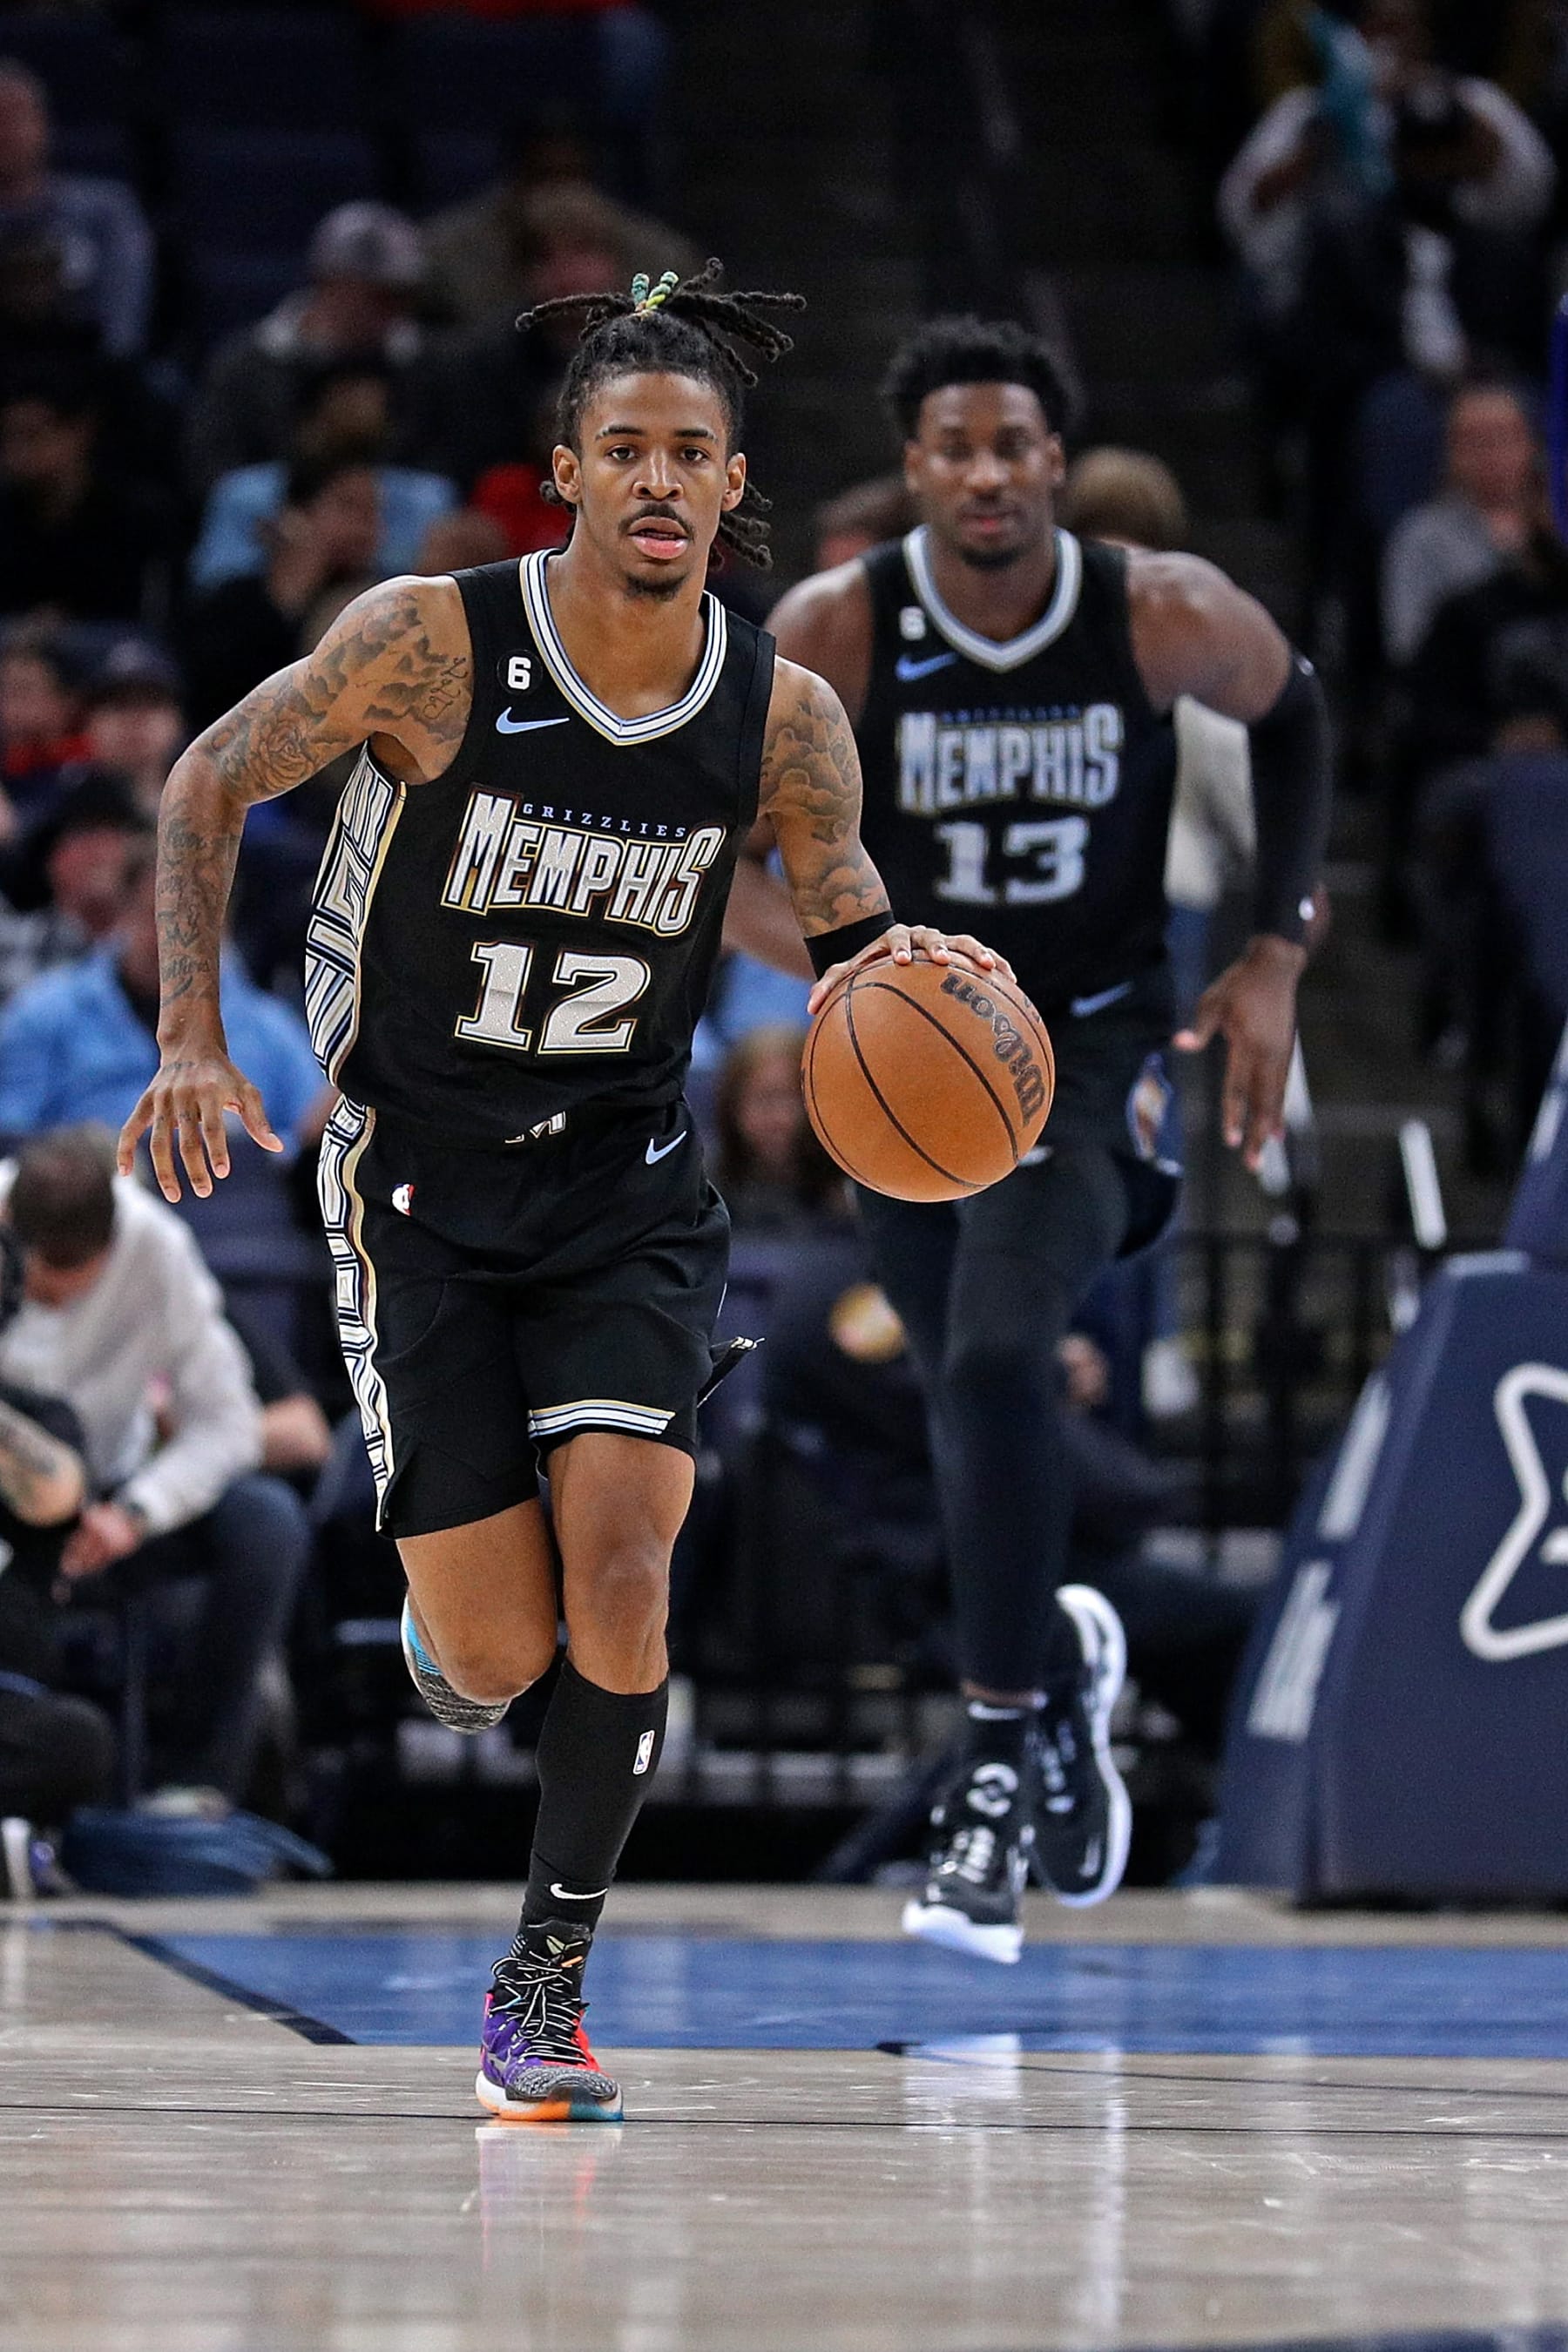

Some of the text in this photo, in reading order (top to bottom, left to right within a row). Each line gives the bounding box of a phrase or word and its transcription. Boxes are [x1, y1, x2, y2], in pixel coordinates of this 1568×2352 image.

[506, 656, 532, 690] 6
[896, 702, 1125, 814] MEMPHIS
[442, 787, 726, 936] MEMPHIS
[522, 802, 686, 838] GRIZZLIES
[934, 815, 1091, 905] 13
[454, 940, 652, 1054] 12
[939, 971, 1046, 1128] Wilson
